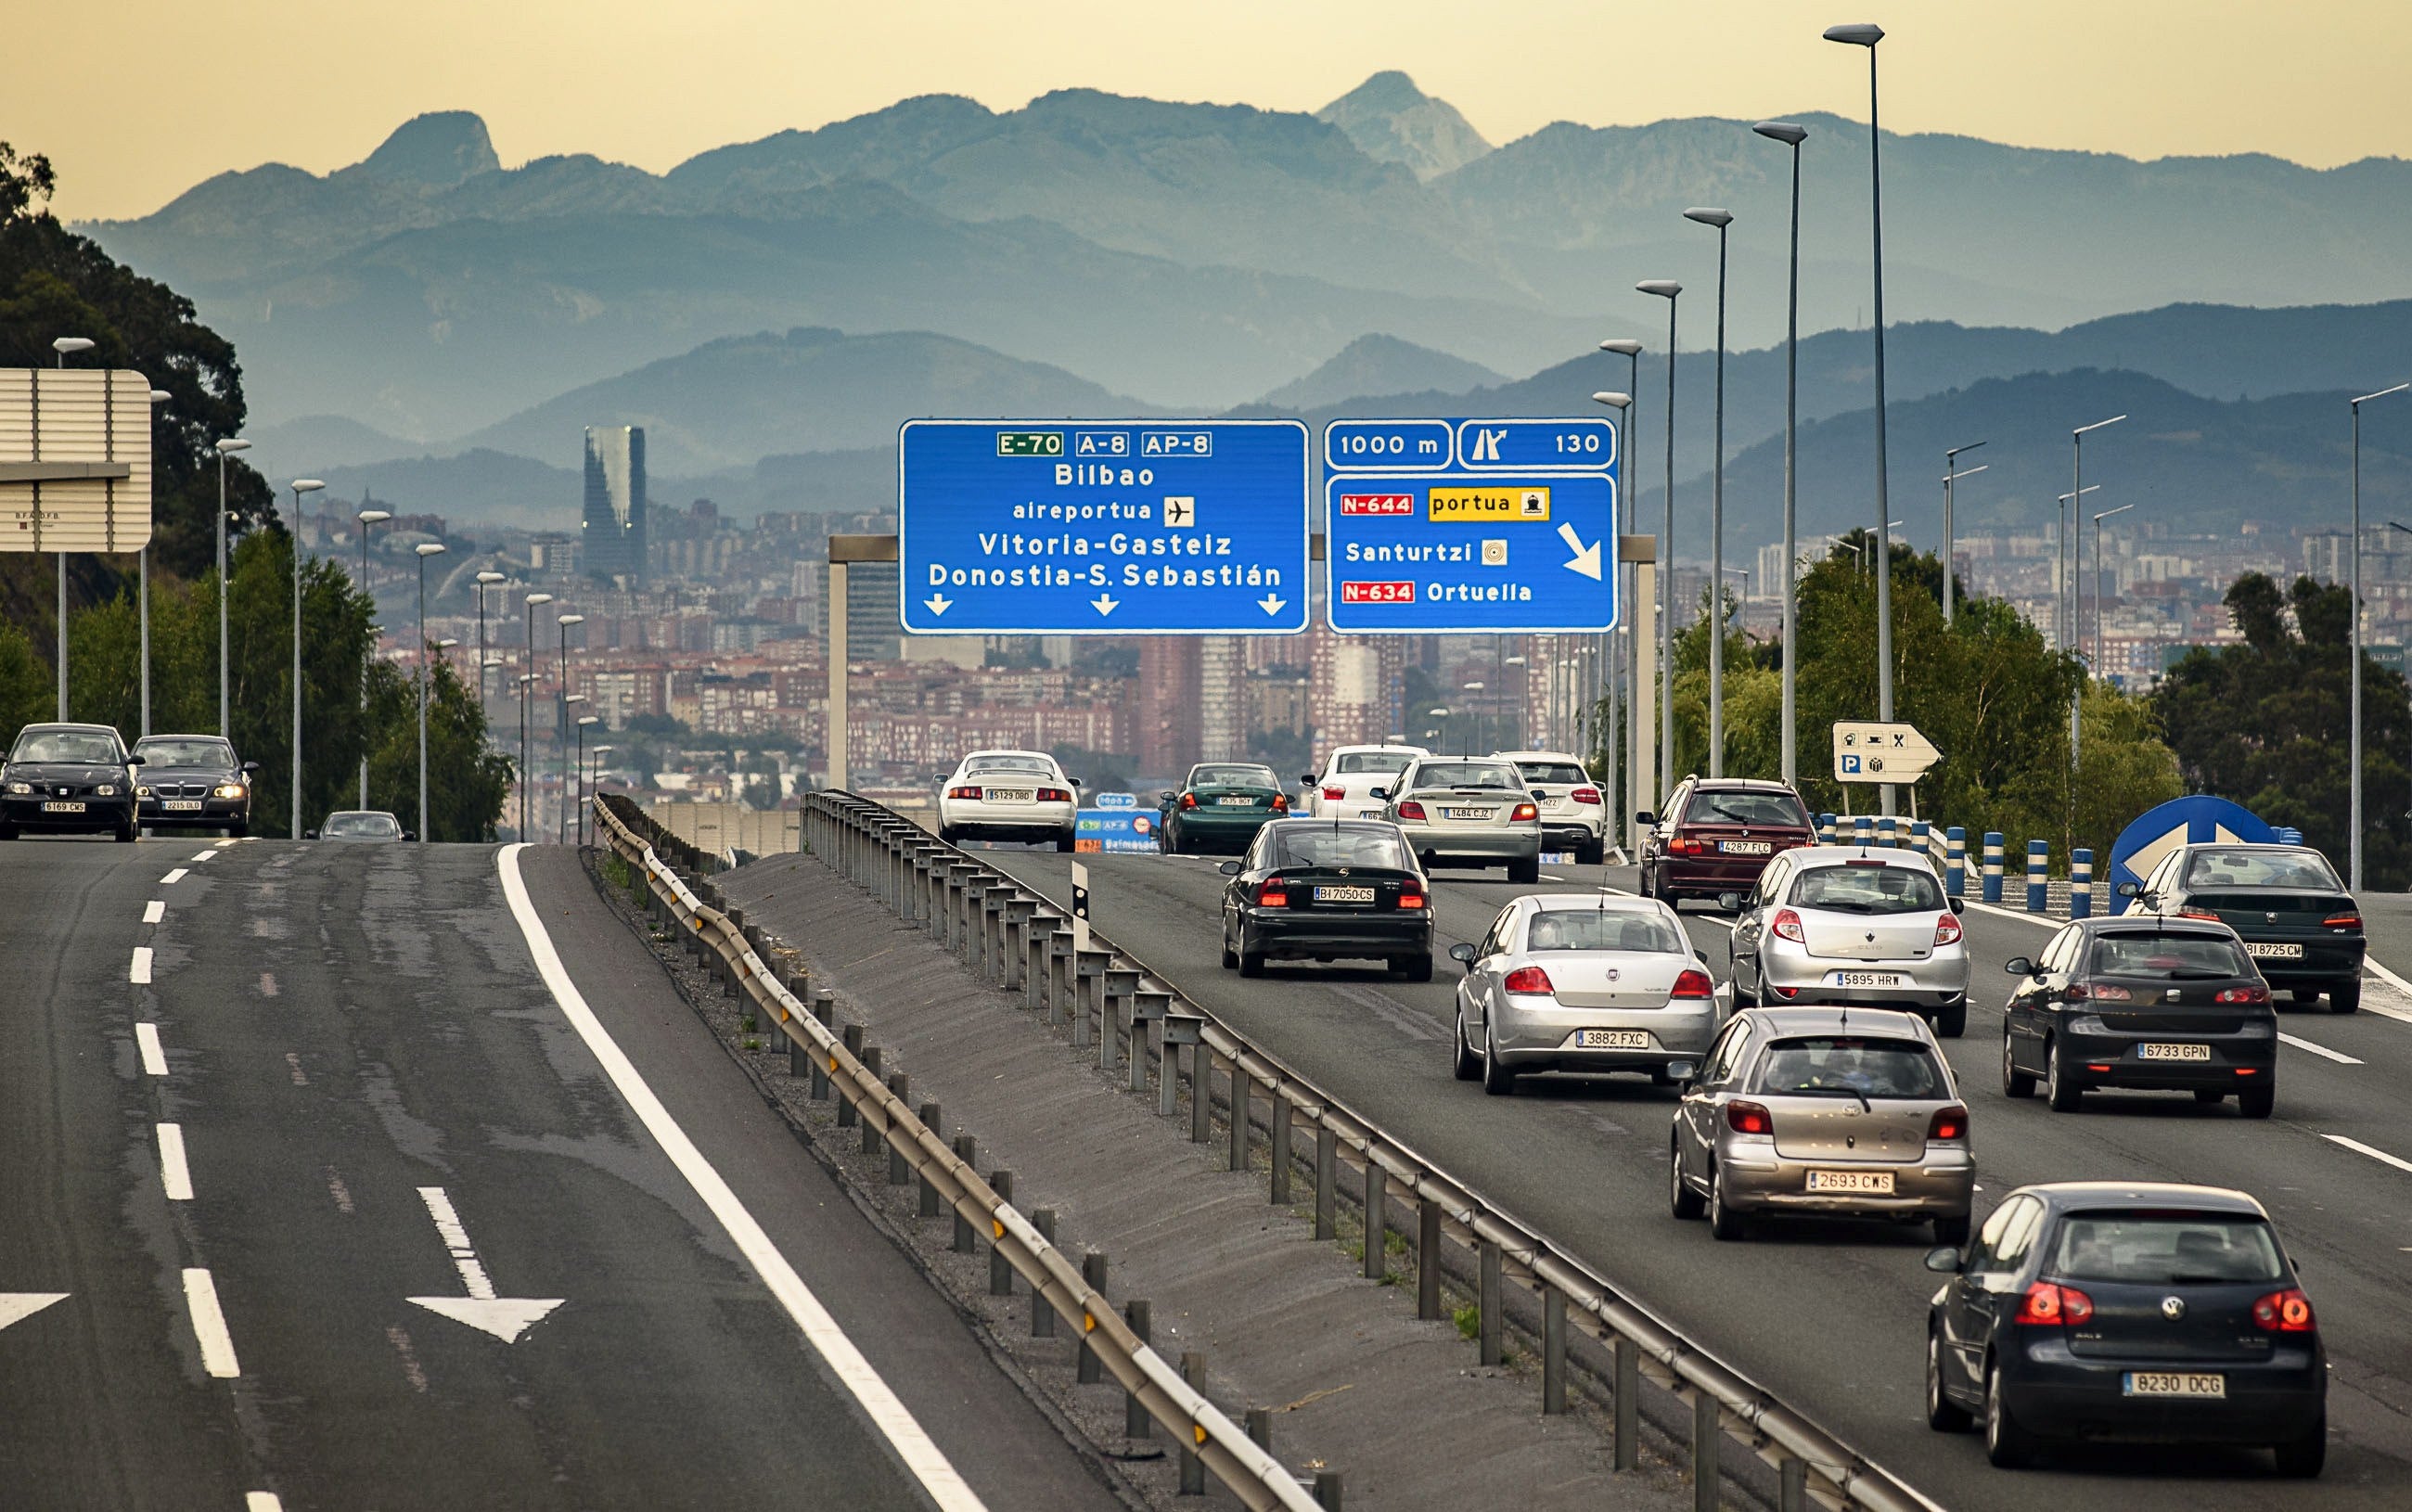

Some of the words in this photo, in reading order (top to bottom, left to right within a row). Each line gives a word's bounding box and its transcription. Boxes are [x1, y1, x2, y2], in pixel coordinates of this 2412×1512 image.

[1000, 435, 1060, 453] E-70
[1079, 435, 1125, 453] A-8
[1146, 435, 1208, 453] AP-8
[1341, 436, 1405, 454] 1000
[1418, 439, 1438, 454] m
[1556, 435, 1599, 453] 130
[1055, 464, 1154, 485] Bilbao
[1343, 497, 1410, 512] N-644
[1433, 494, 1509, 514] portua
[1013, 502, 1151, 523] aireportua
[979, 533, 1231, 555] Vitoria-Gasteiz
[1346, 543, 1471, 561] Santurtzi
[930, 564, 1112, 586] Donostia-S.
[1123, 564, 1281, 586] Sebastián
[1345, 585, 1411, 600] N-634
[1428, 583, 1532, 601] Ortuella
[1845, 756, 1857, 772] P
[994, 791, 1013, 800] 5129
[46, 802, 67, 811] 6169
[1452, 809, 1471, 817] 1484
[1473, 809, 1489, 817] CJZ
[1725, 842, 1749, 852] 4287
[1751, 843, 1769, 852] FLC
[2246, 944, 2257, 955] BI
[2259, 944, 2286, 955] 8725
[2287, 945, 2301, 956] CM
[1844, 974, 1874, 985] 5895
[1878, 975, 1899, 986] HRW
[1588, 1032, 1617, 1044] 3882
[1621, 1033, 1643, 1044] FXC
[2147, 1045, 2179, 1057] 6733
[2183, 1046, 2207, 1057] GPN
[1820, 1173, 1856, 1188] 2693
[1862, 1175, 1890, 1189] CWS
[2138, 1376, 2180, 1391] 8230
[2188, 1377, 2220, 1392] DCG
